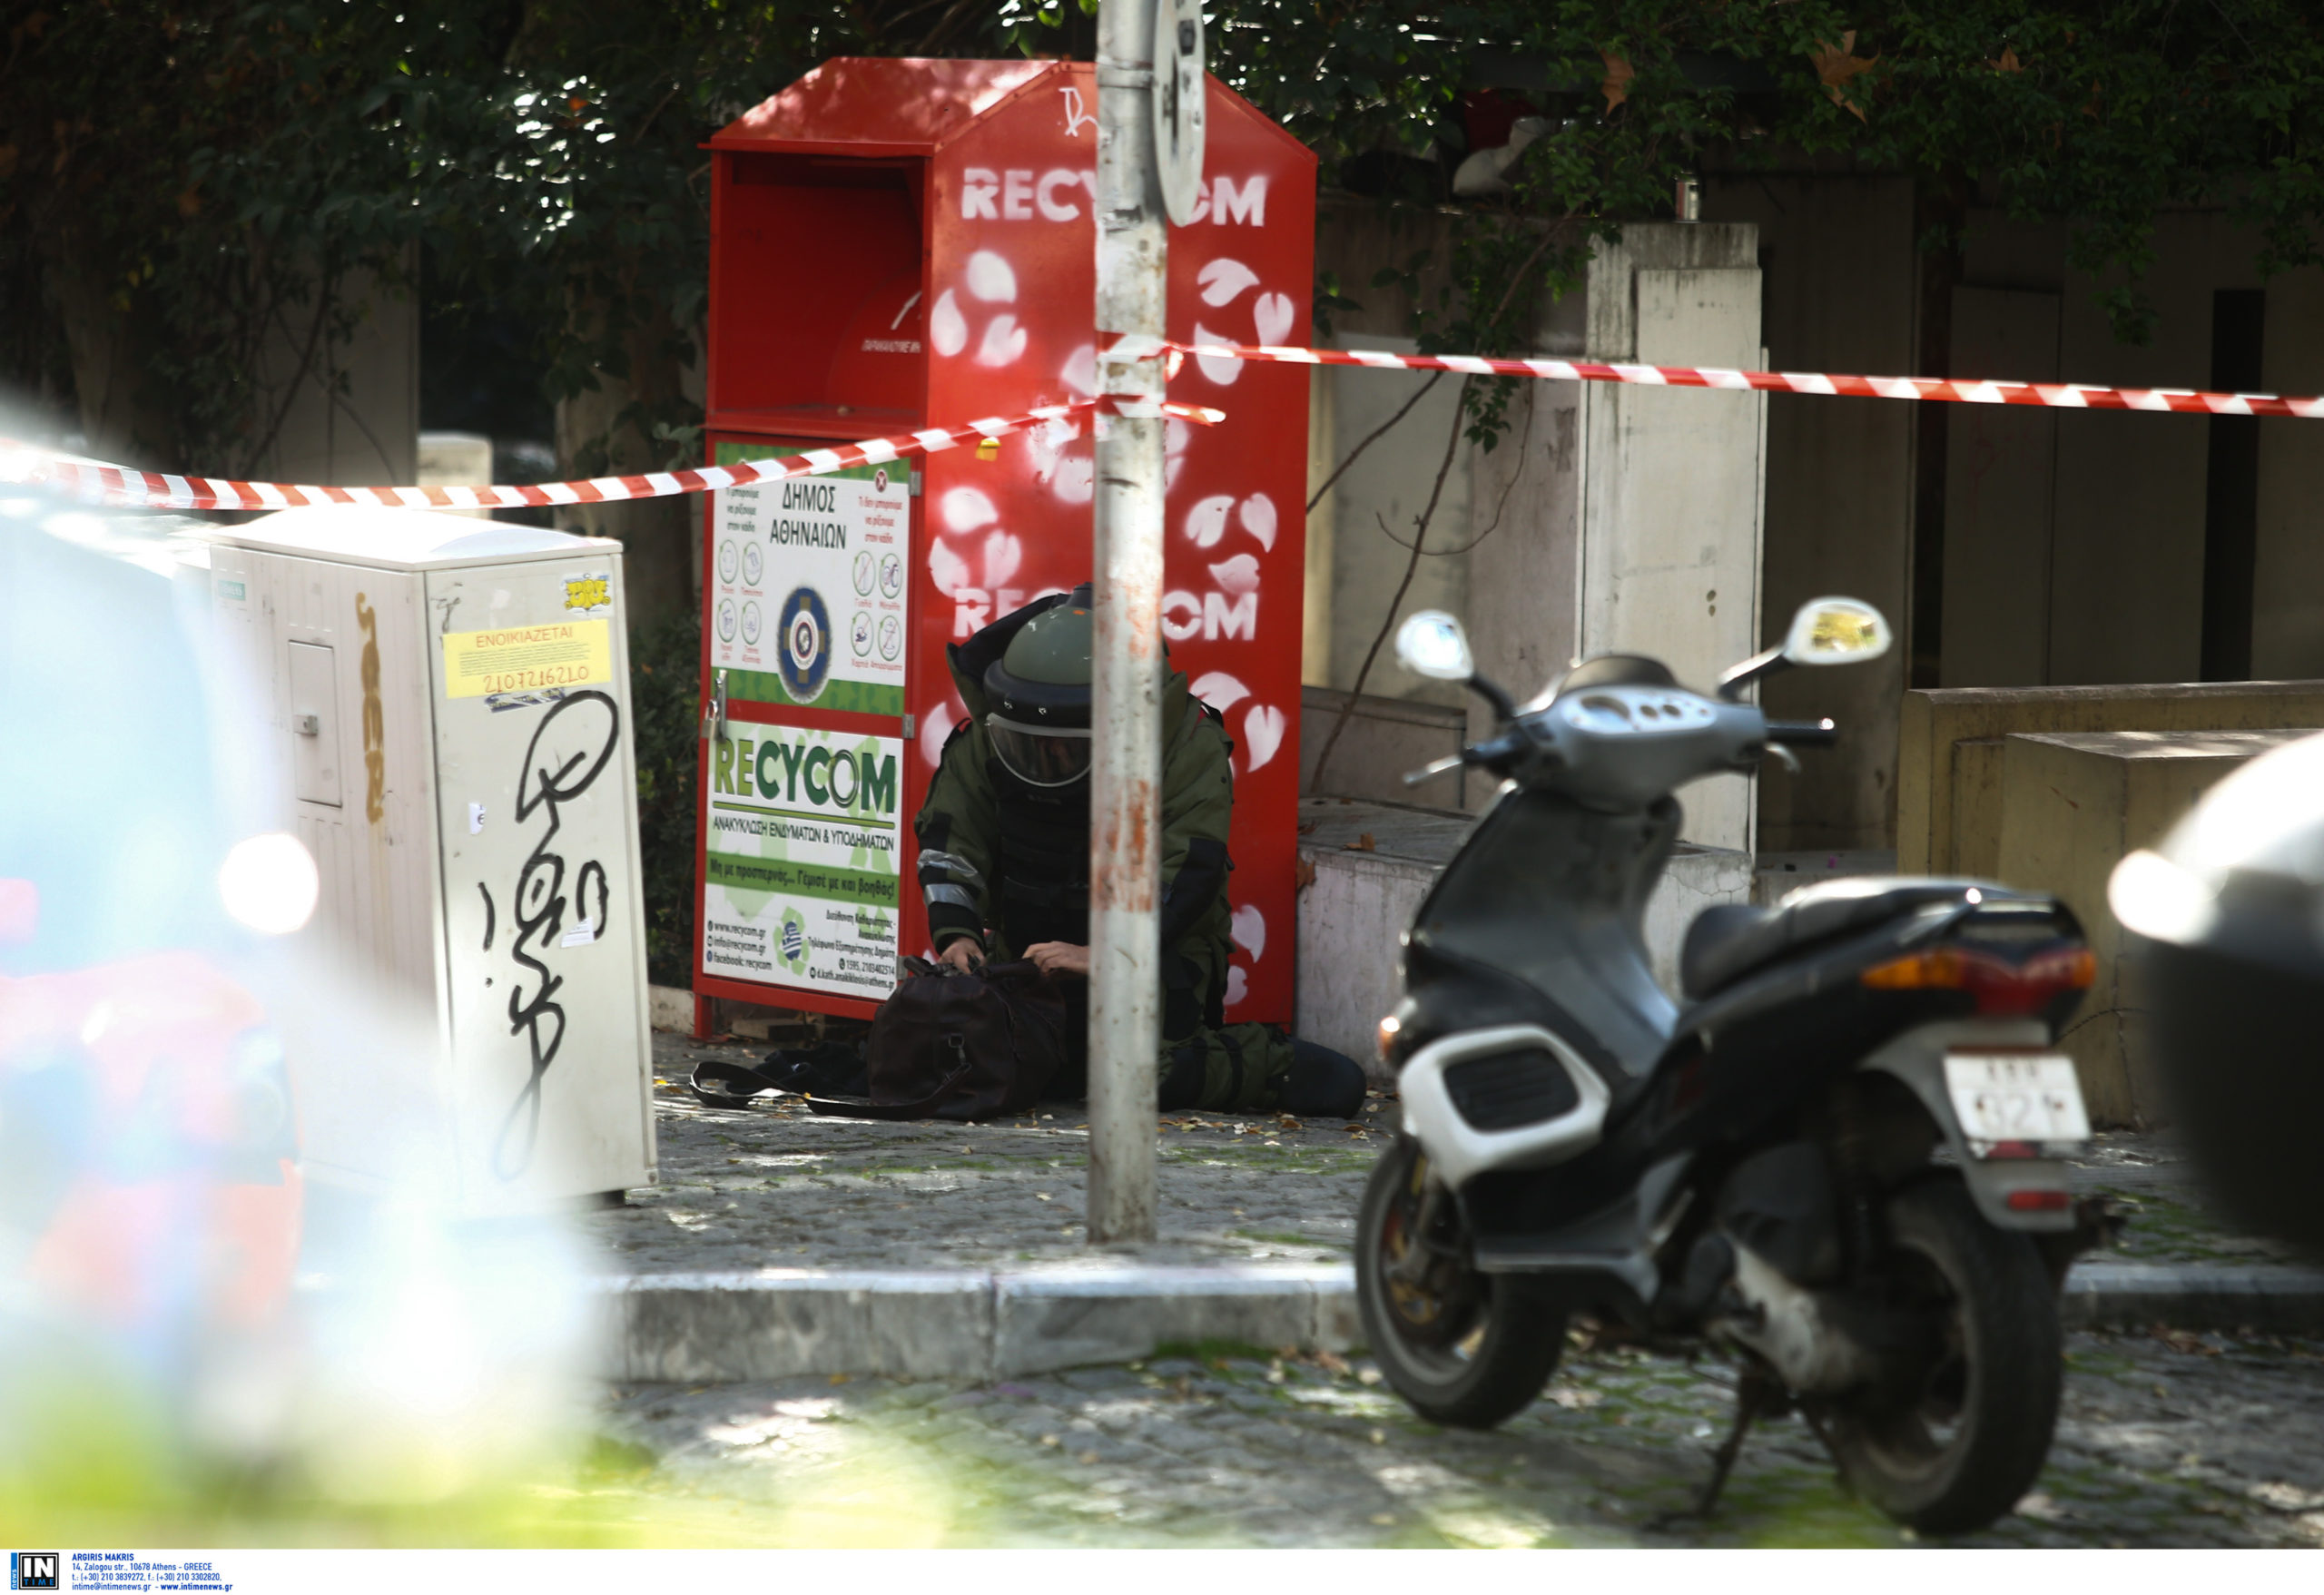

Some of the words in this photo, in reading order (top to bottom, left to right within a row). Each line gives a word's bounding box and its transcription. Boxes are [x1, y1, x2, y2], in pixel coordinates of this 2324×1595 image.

[782, 482, 836, 514] ΔΗΜΟΣ
[769, 518, 847, 550] ΑΘΗΝΑΙΩΝ
[476, 625, 574, 648] ΕΝΟΙΚΙΑΖΕΤΑΙ
[714, 738, 896, 813] RECYCOM
[714, 815, 767, 836] ΑΝΑΚΥΚΛΩΣΗ
[770, 822, 822, 843] ΕΝΔΥΜΑΤΩΝ
[822, 830, 830, 843] &
[831, 829, 895, 852] ΥΠΟΔΗΜΑΤΩΝ
[710, 858, 723, 879] Μη
[724, 863, 734, 878] με
[828, 877, 840, 892] με
[842, 880, 856, 891] και
